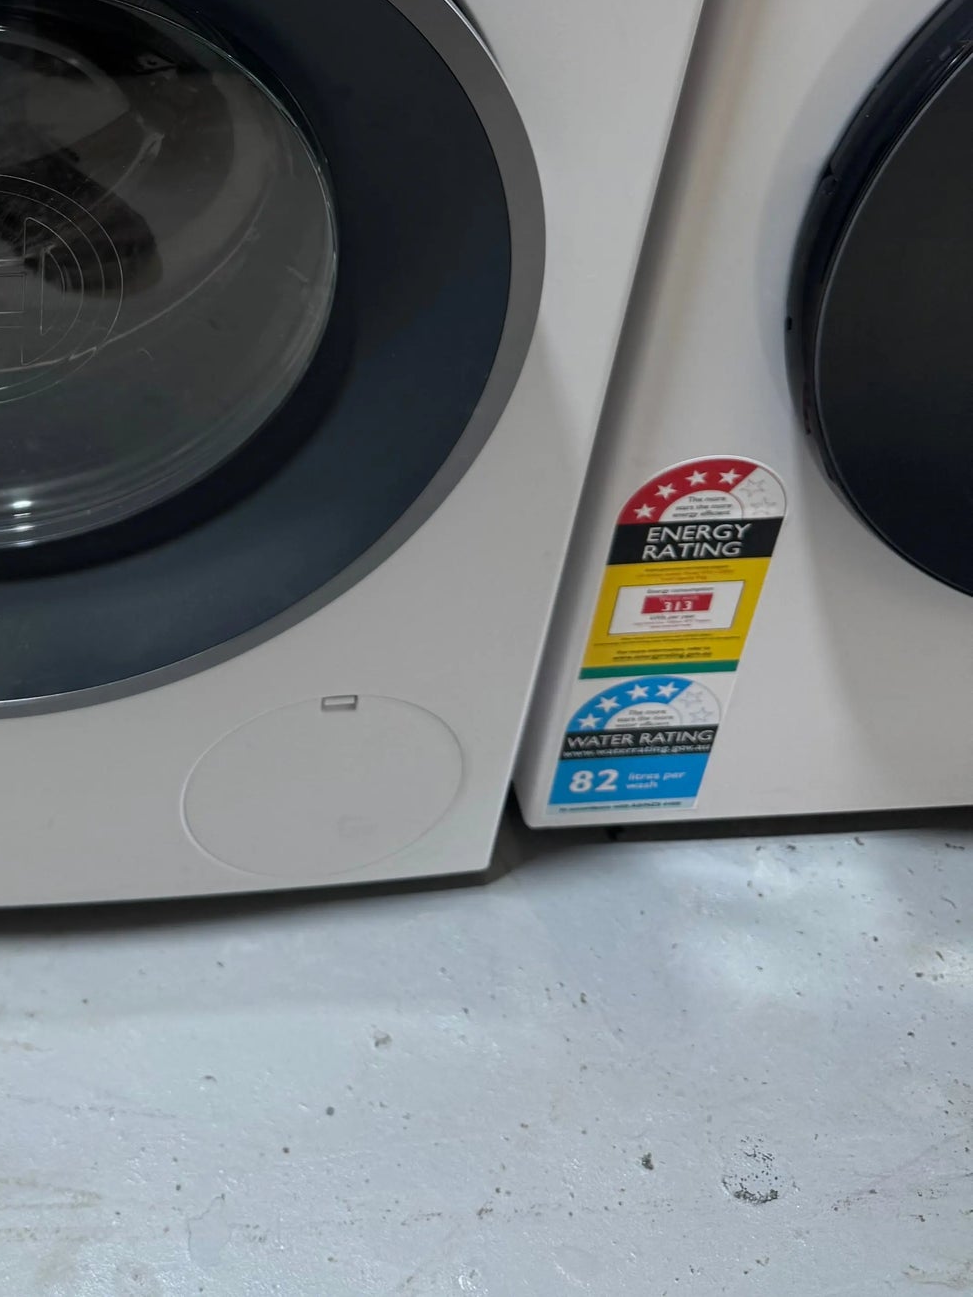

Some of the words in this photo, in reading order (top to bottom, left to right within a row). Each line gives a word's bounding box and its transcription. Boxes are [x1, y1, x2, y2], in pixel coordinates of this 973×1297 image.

[646, 523, 752, 543] ENERGY
[642, 541, 744, 561] RATING
[661, 600, 694, 612] 313
[567, 734, 634, 749] WATER
[639, 729, 715, 746] RATING
[569, 769, 619, 793] 82
